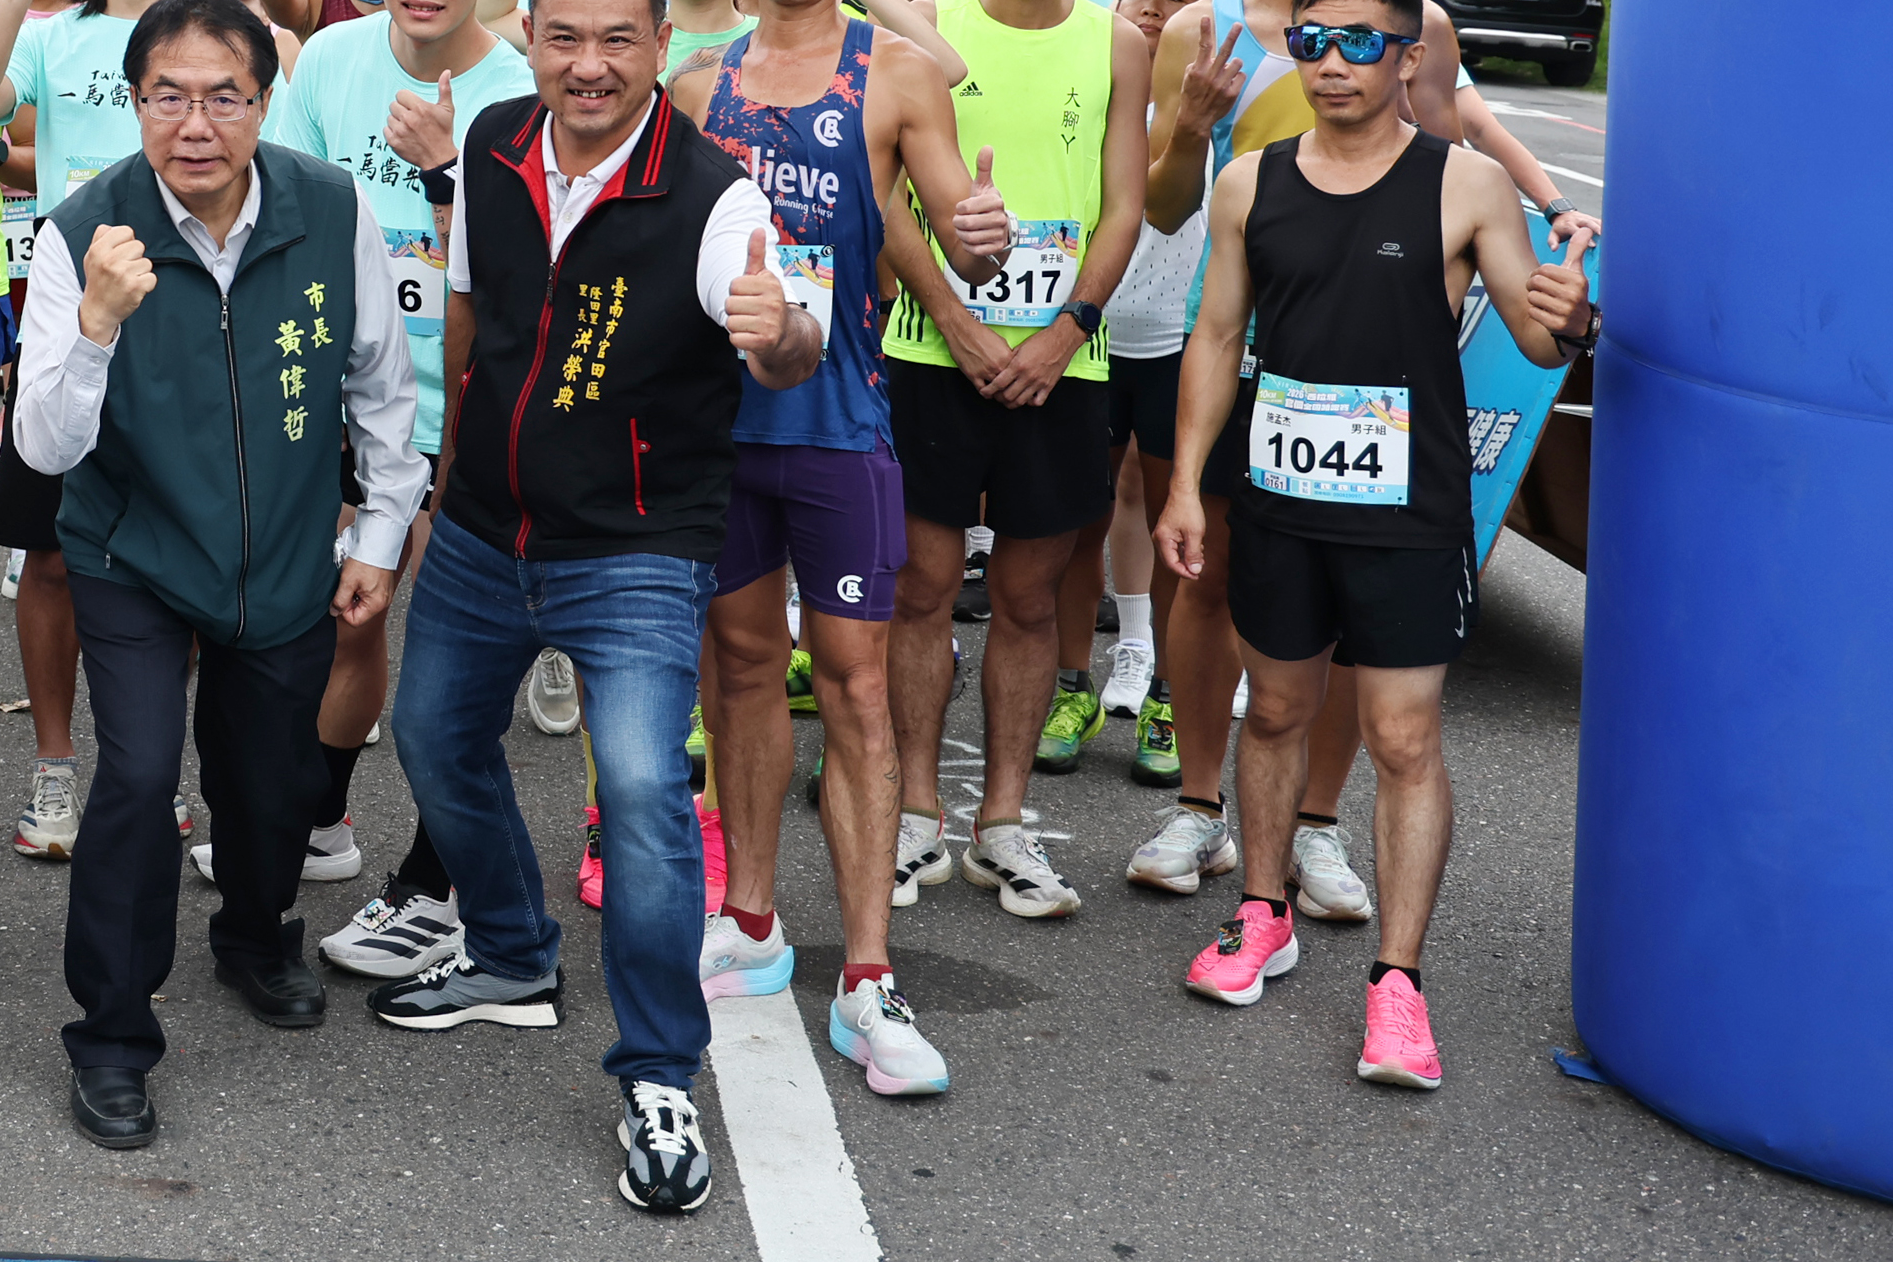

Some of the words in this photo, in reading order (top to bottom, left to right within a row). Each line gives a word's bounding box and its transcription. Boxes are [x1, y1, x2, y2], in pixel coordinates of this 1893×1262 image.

[57, 83, 130, 109] 一馬當
[1061, 87, 1081, 155] 大腳丫
[70, 170, 90, 178] 10KM
[736, 146, 840, 205] lieve
[773, 195, 809, 215] Running
[6, 237, 35, 263] 13
[1040, 253, 1064, 264] 男子組
[304, 281, 333, 349] 市長
[586, 276, 629, 401] 臺南市官田區
[274, 320, 309, 442] 黃偉哲
[553, 327, 593, 413] 洪榮典
[1259, 390, 1278, 399] 10KM
[1286, 388, 1304, 399] 2026
[1351, 424, 1387, 435] 男子組
[1466, 408, 1521, 474] 健康
[1268, 431, 1383, 479] 1044
[1265, 477, 1284, 490] 0161
